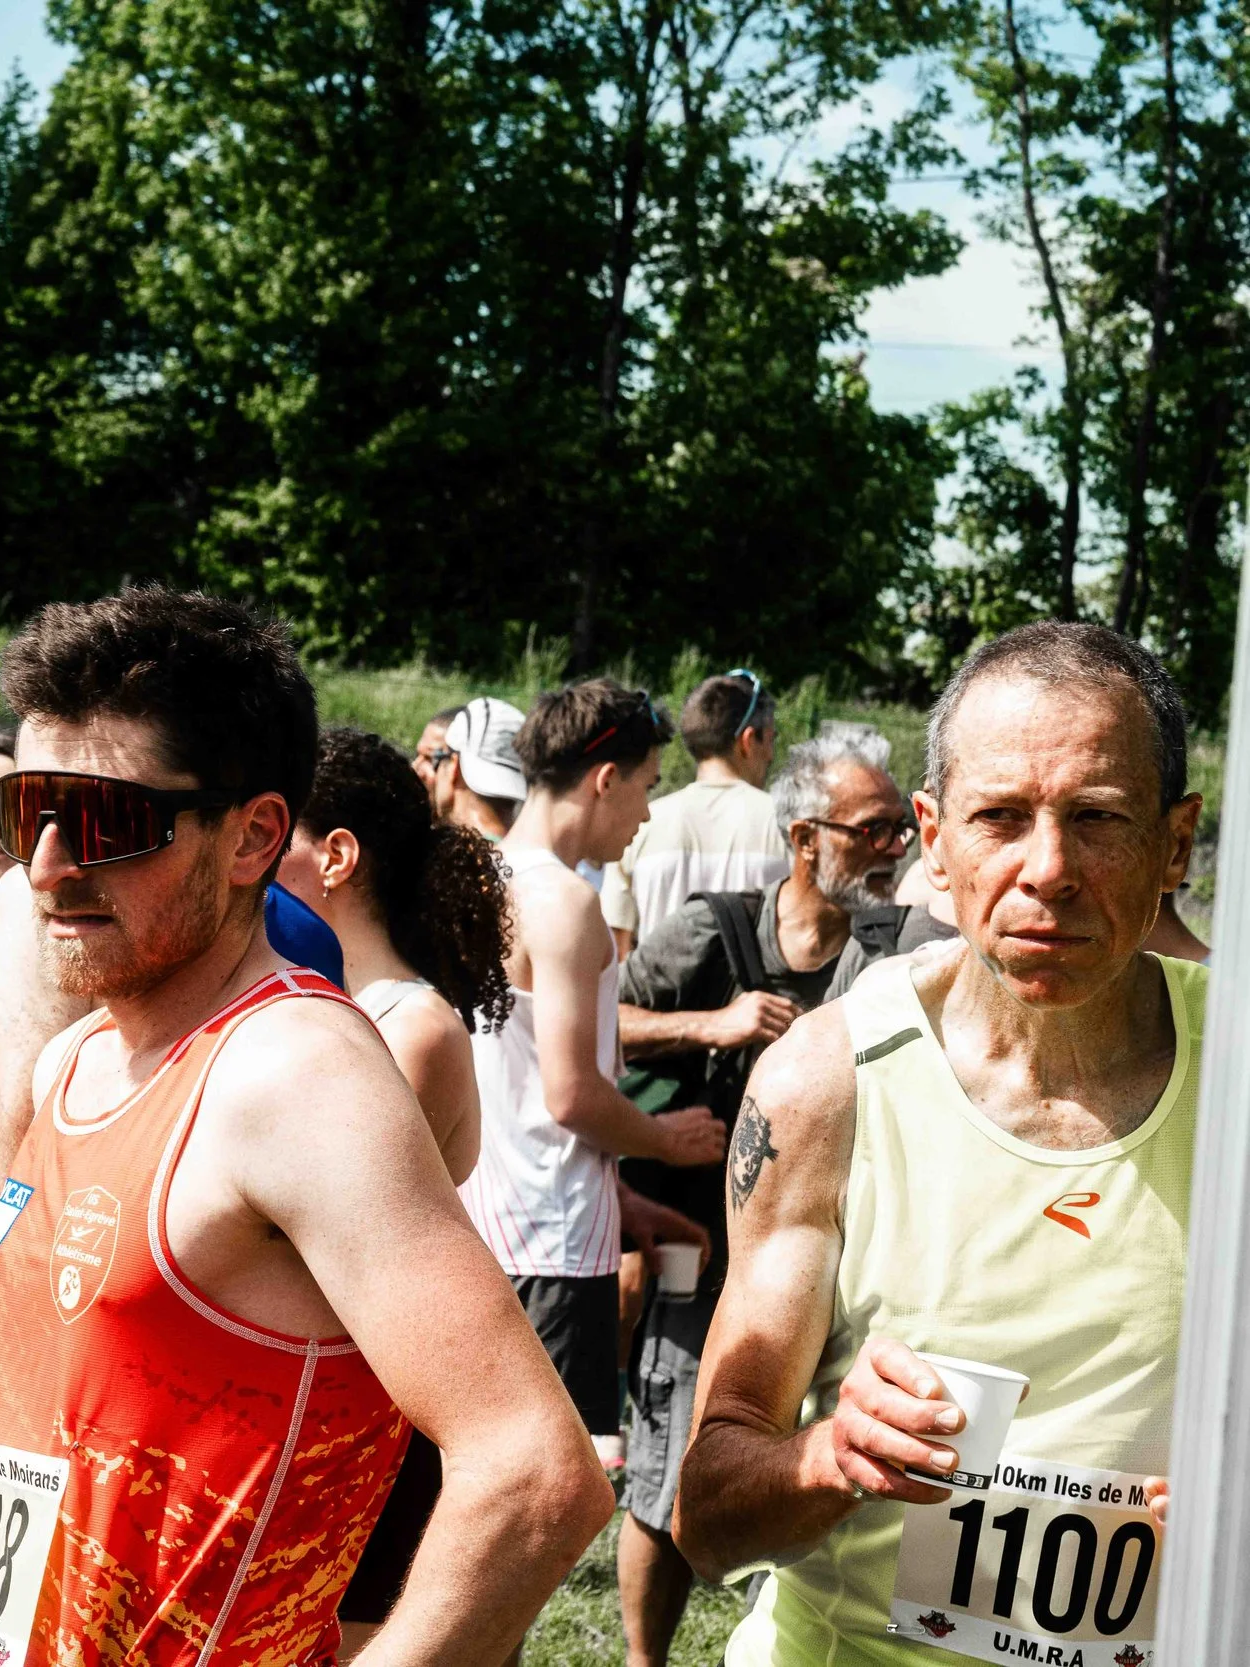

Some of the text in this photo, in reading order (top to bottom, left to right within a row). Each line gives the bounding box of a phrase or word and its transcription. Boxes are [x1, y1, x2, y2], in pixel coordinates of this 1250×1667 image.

[8, 1459, 60, 1493] Moirans
[993, 1463, 1047, 1492] 10km
[1098, 1482, 1123, 1504] de
[1127, 1485, 1150, 1508] M
[949, 1498, 1156, 1636] 1100
[993, 1631, 1085, 1667] U.M.R.A
